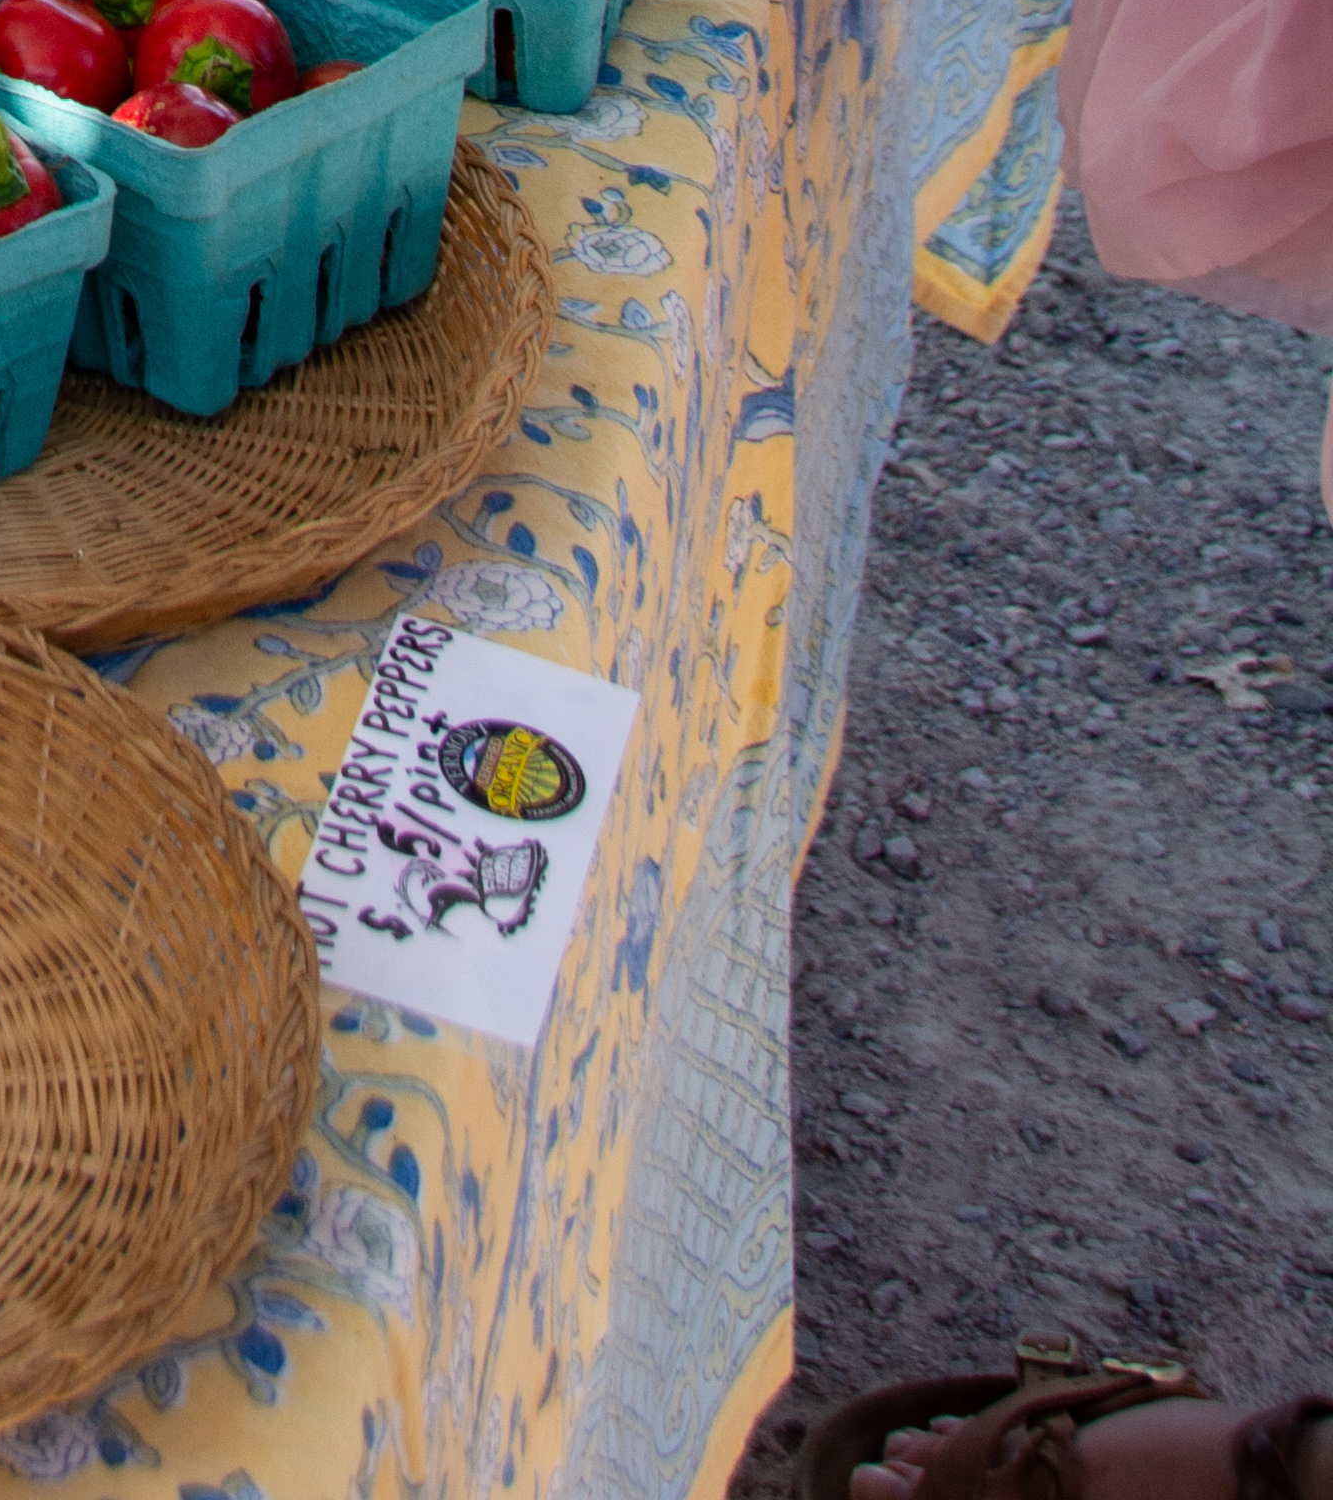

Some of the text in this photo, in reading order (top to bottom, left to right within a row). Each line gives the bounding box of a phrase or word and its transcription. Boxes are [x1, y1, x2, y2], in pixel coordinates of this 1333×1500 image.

[315, 735, 399, 877] CHERRY
[361, 618, 454, 738] PEPPERS
[441, 722, 489, 795] VERMONT
[490, 728, 533, 808] ORGANIC
